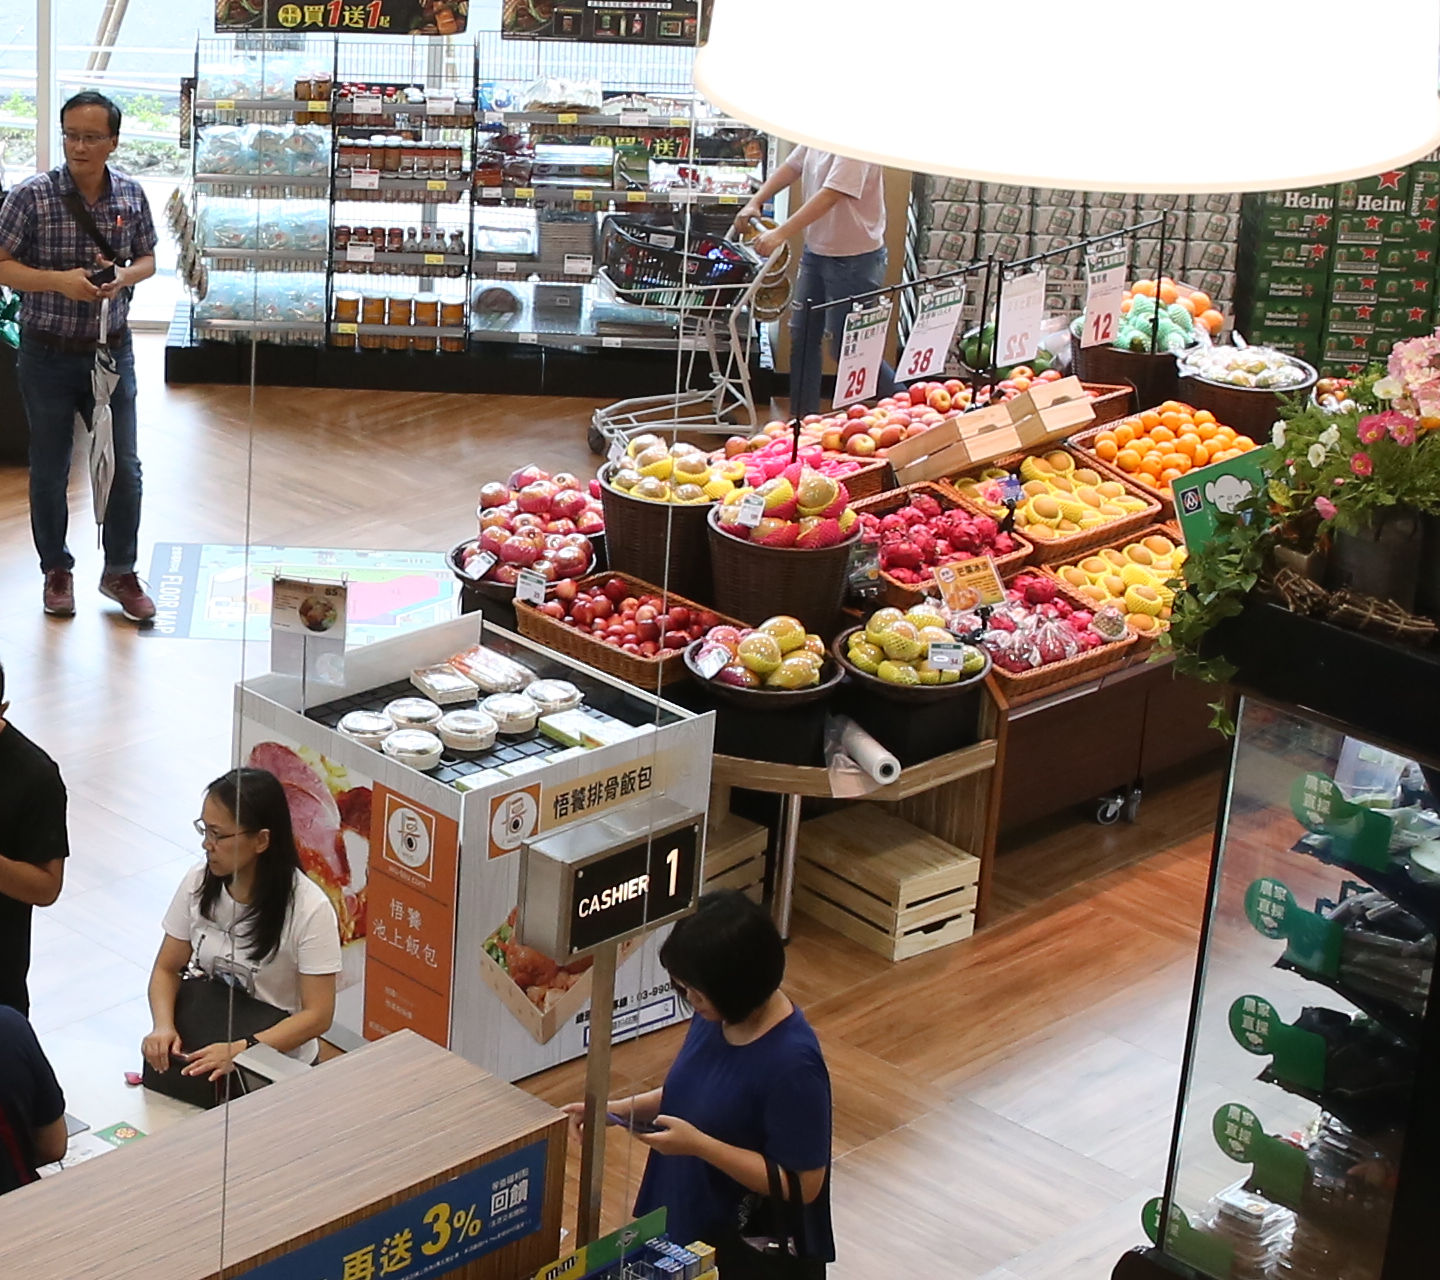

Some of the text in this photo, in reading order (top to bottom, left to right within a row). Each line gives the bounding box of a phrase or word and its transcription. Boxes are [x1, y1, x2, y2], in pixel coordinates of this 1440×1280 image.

[1092, 312, 1113, 341] 12
[907, 347, 935, 376] 38
[844, 368, 867, 399] 29
[577, 846, 680, 919] CASHIER 1
[372, 917, 439, 970] 池上飯包
[422, 1201, 481, 1257] 3%
